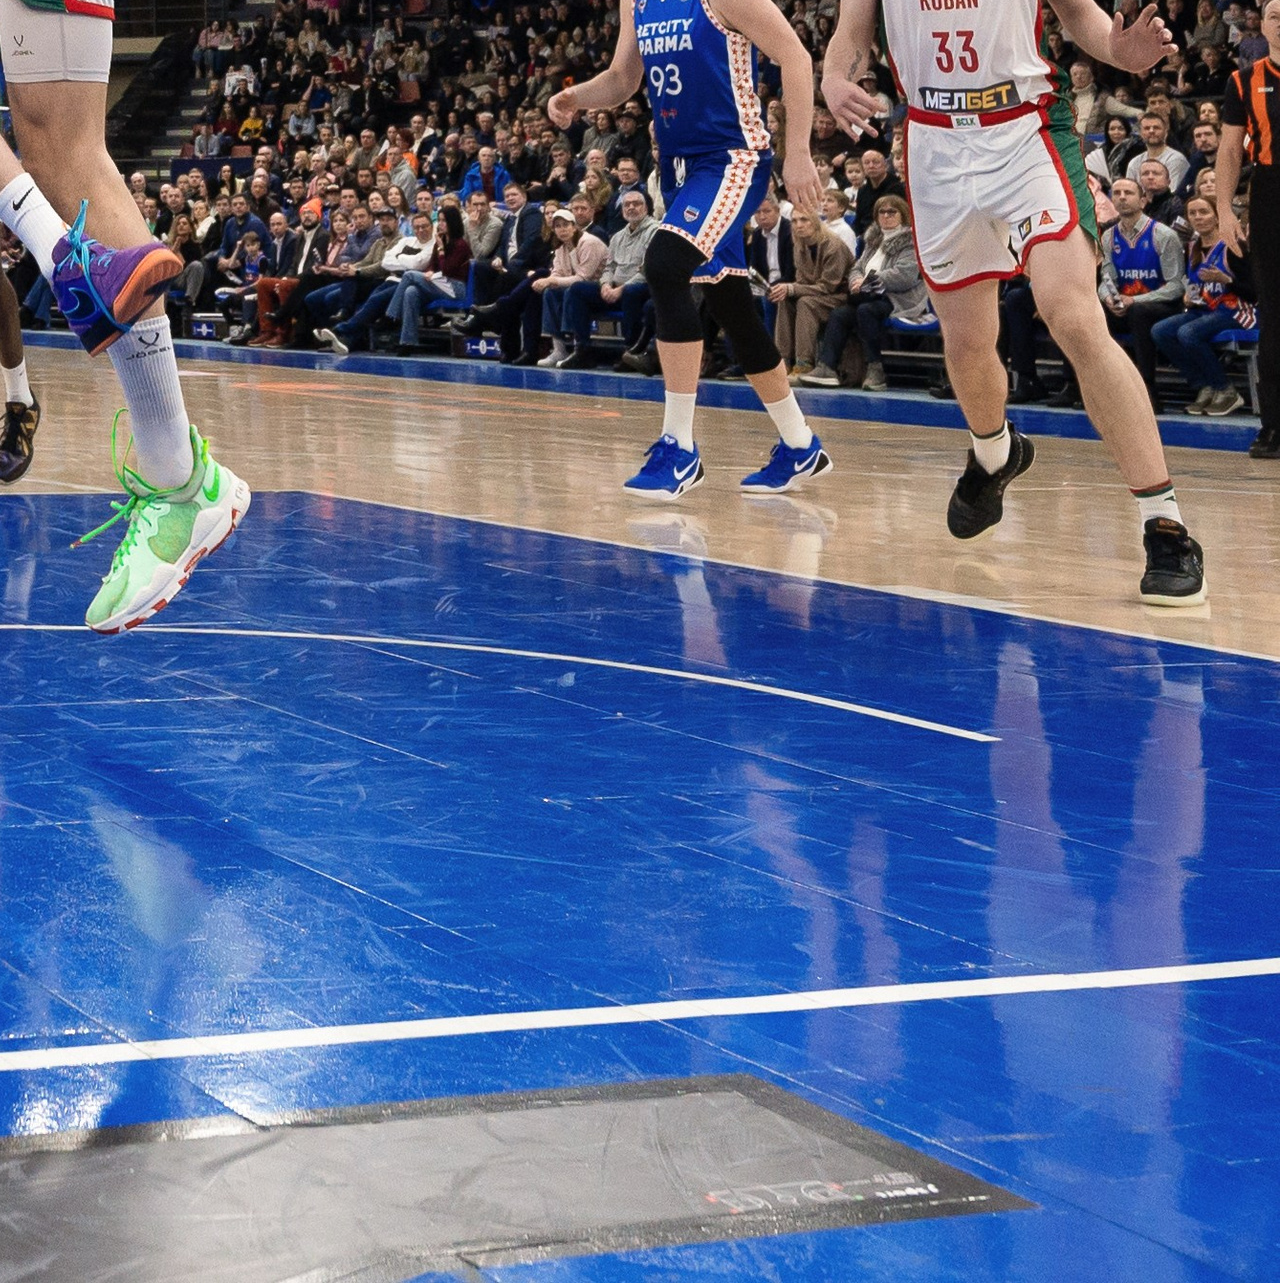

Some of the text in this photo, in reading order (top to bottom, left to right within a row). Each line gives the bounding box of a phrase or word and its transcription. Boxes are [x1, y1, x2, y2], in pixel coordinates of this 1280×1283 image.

[931, 30, 979, 74] 33
[650, 63, 683, 97] 93
[925, 84, 1012, 111] МЕЛБЕТ
